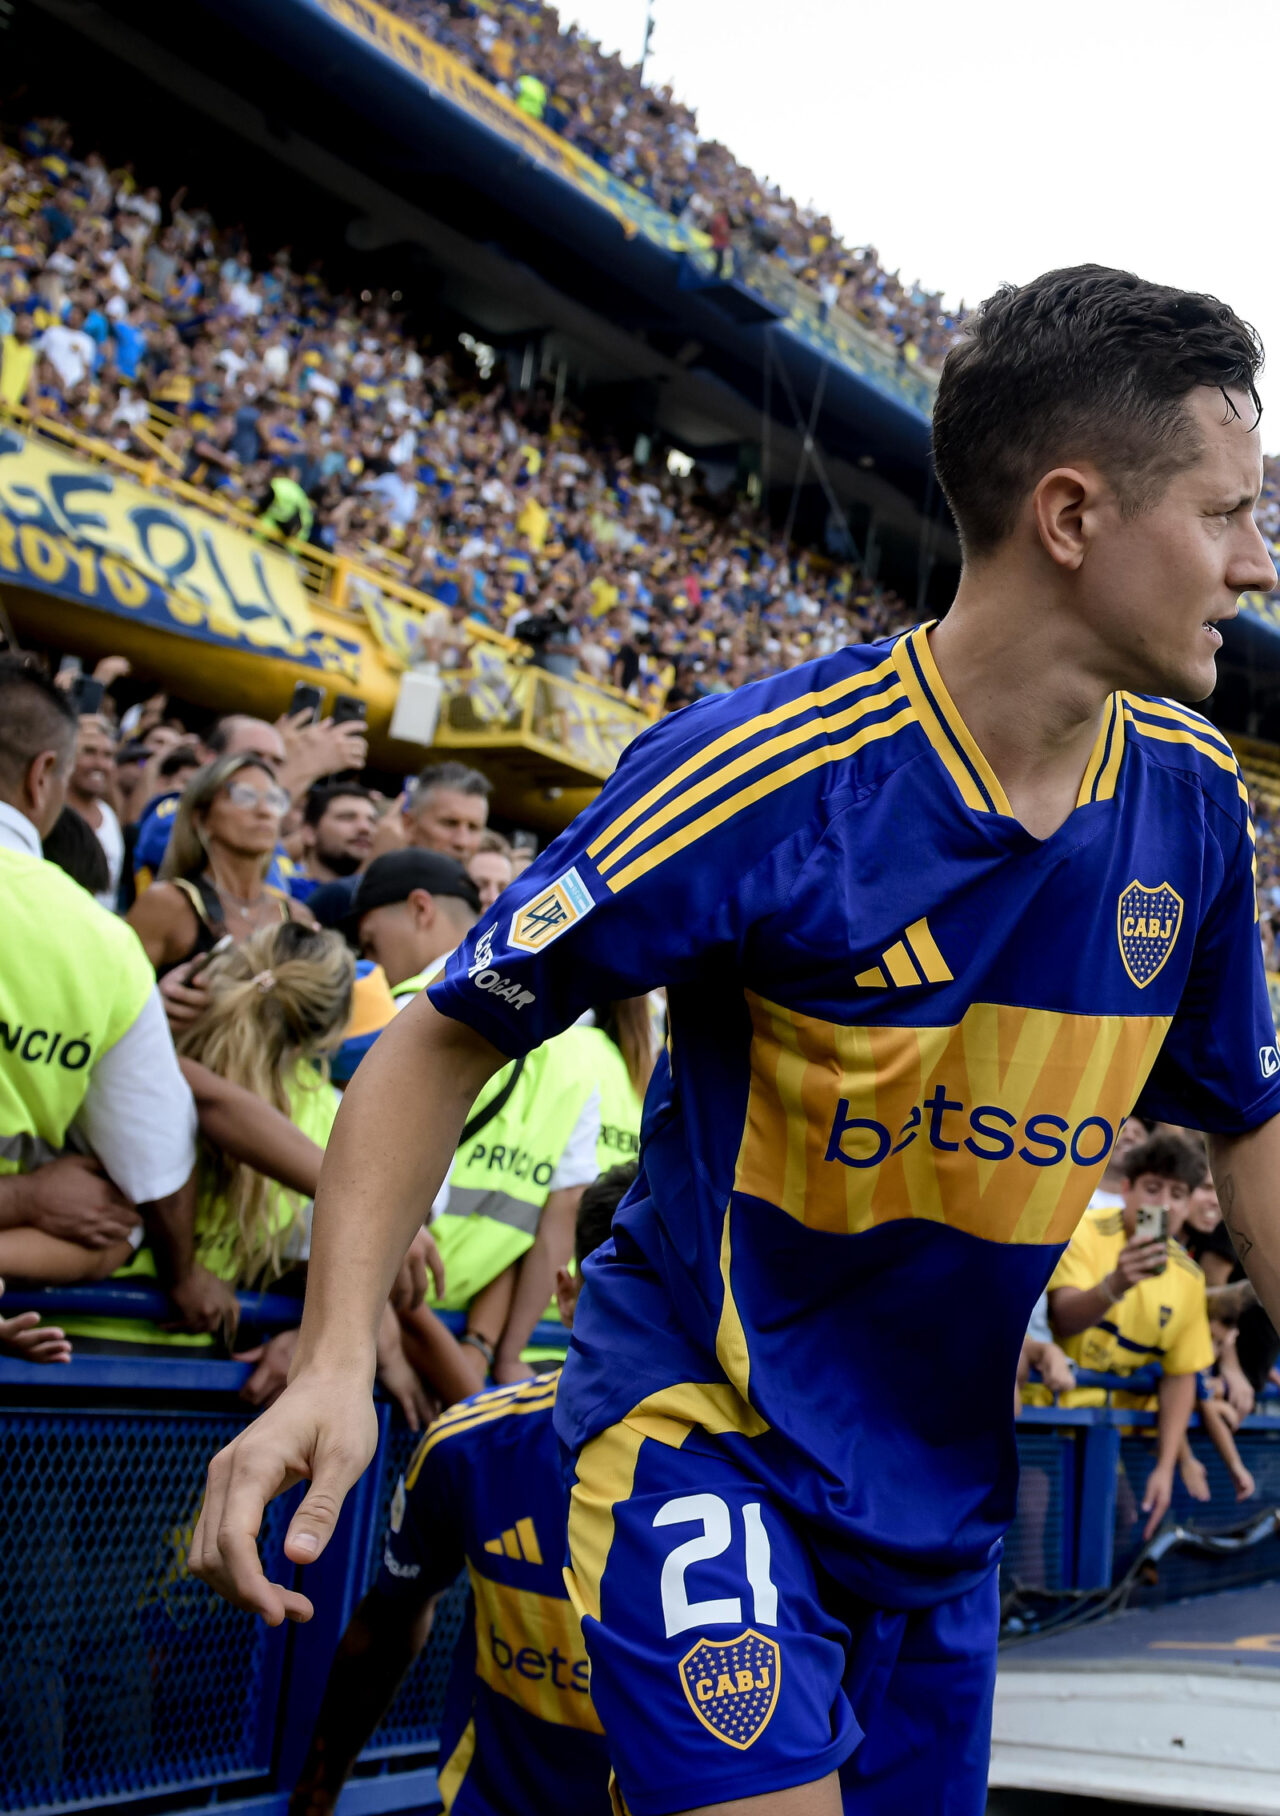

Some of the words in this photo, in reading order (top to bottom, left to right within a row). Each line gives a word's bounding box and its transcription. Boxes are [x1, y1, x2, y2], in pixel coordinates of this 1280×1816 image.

[1123, 916, 1173, 939] CABJ
[824, 1084, 1128, 1168] betsso
[652, 1493, 778, 1639] 21
[489, 1622, 590, 1694] bets
[695, 1666, 771, 1702] CABJ
